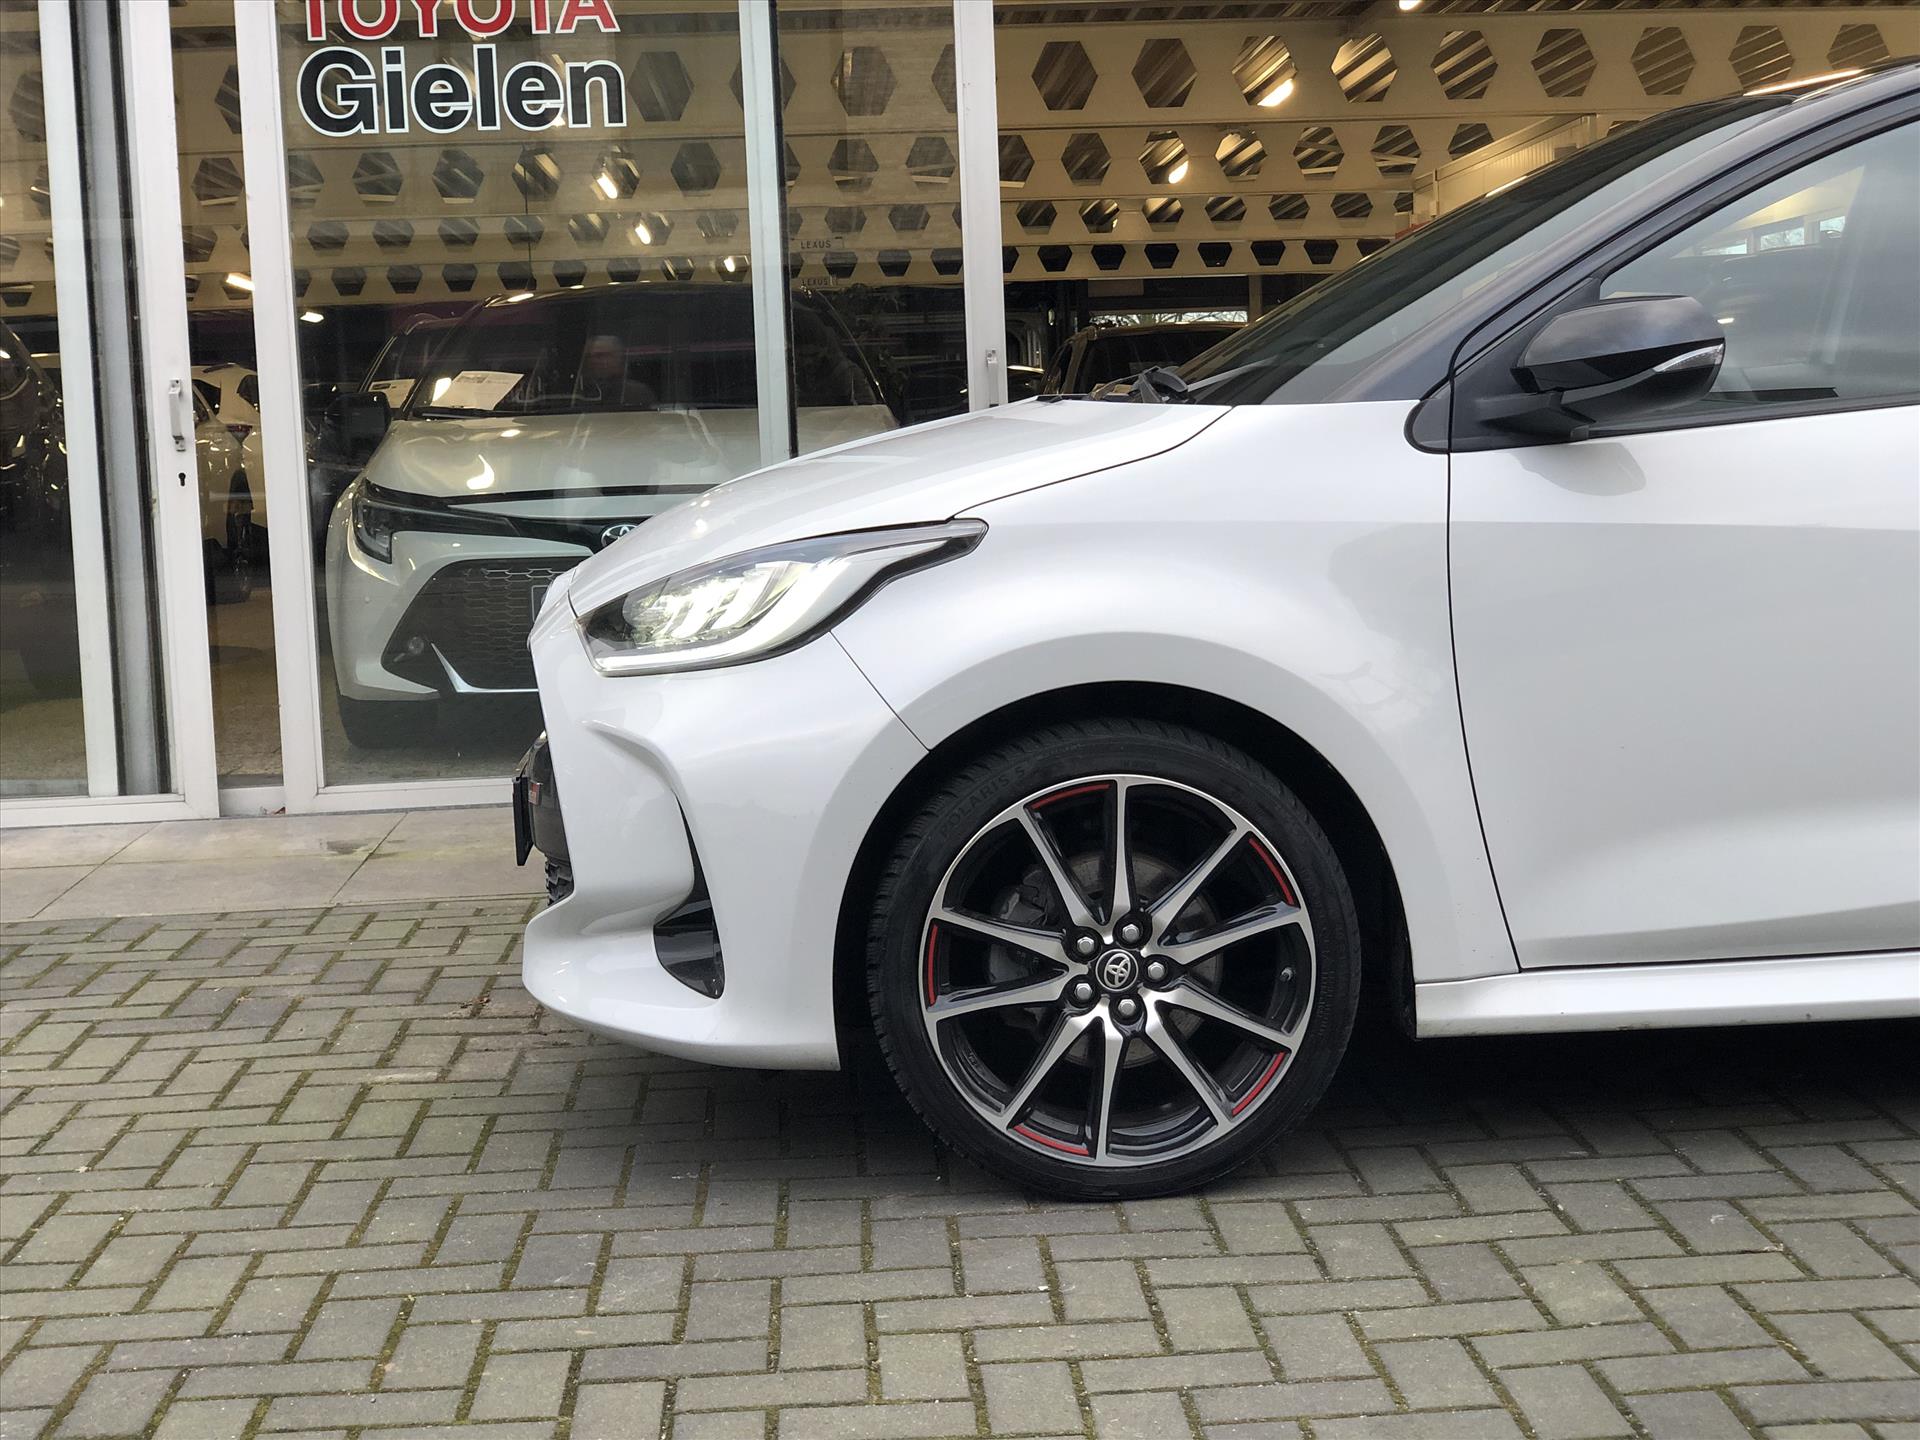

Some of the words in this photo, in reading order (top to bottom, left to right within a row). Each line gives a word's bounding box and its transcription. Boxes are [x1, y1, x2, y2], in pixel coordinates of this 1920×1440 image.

[297, 44, 628, 137] Gielen
[800, 240, 831, 249] LEXUS
[940, 776, 1010, 835] POLARIS
